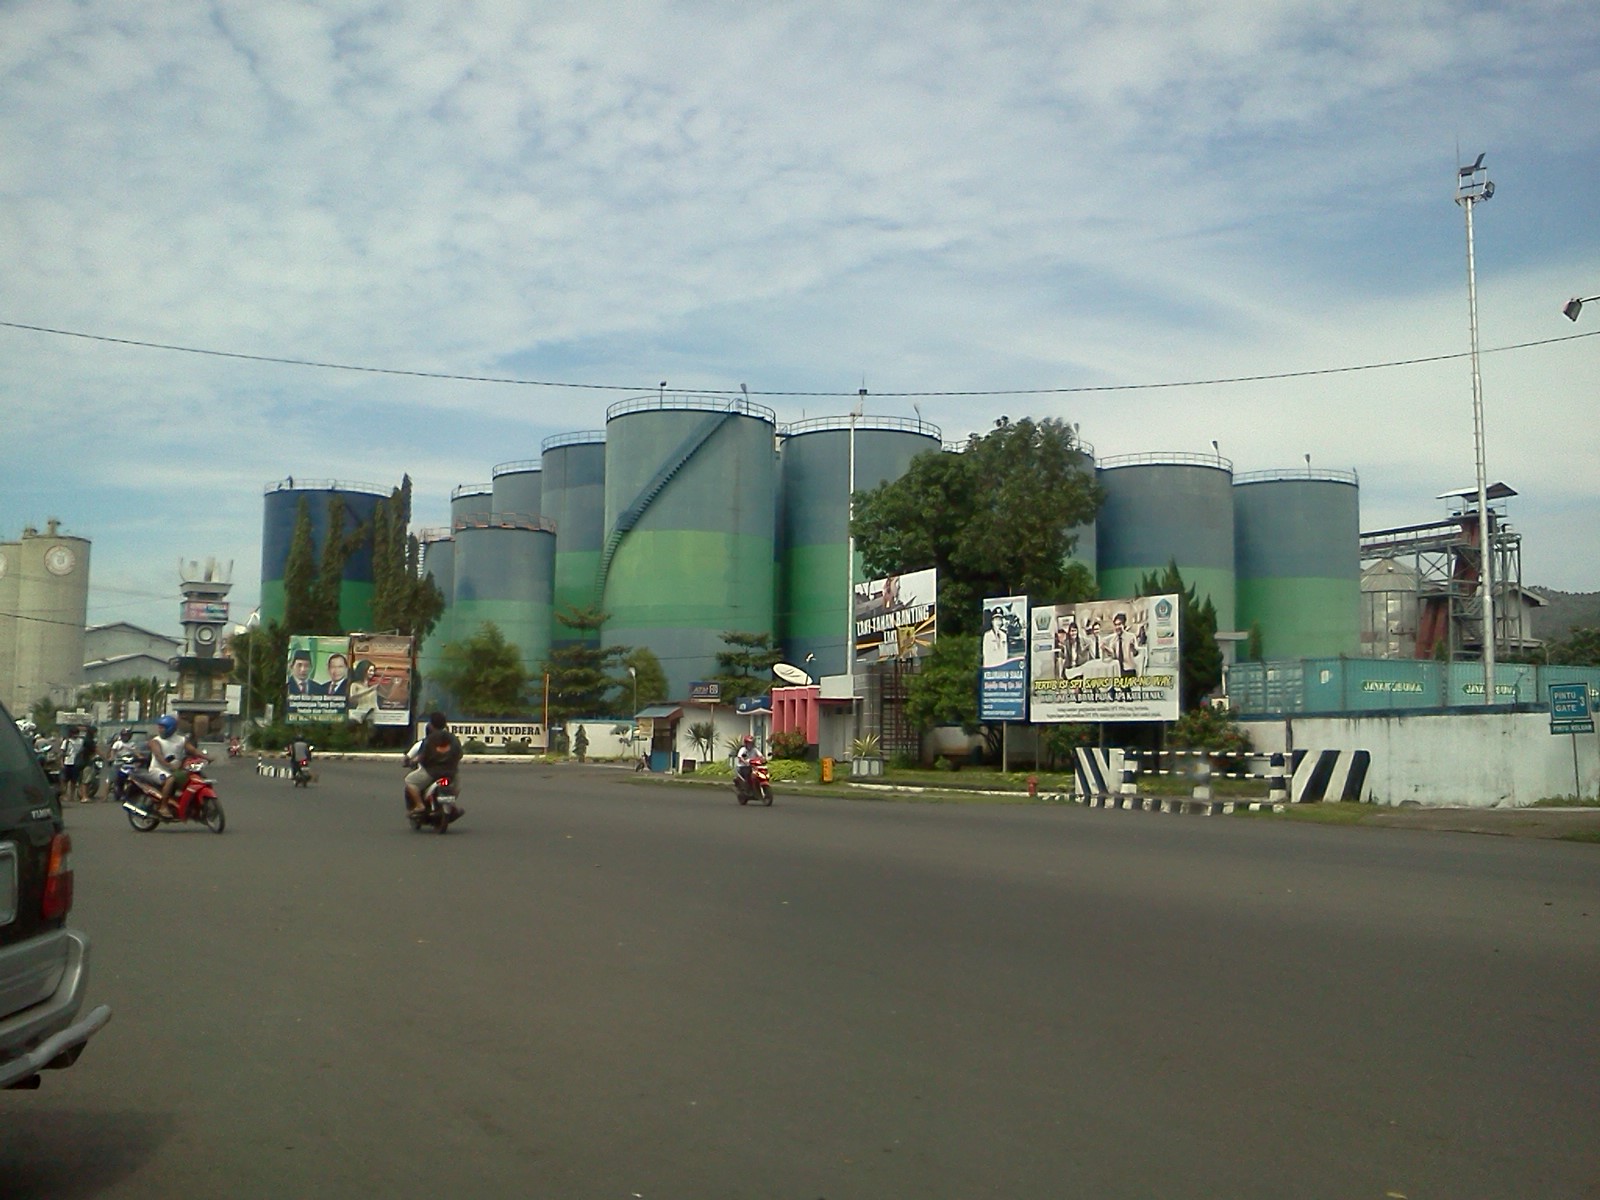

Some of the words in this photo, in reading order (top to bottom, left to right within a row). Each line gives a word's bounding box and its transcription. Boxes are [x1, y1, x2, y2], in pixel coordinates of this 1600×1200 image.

[895, 605, 929, 626] BANTING
[1579, 696, 1585, 706] 3
[1555, 704, 1577, 712] GATE
[451, 726, 485, 735] BUHAN
[489, 727, 541, 735] SAMUDERA
